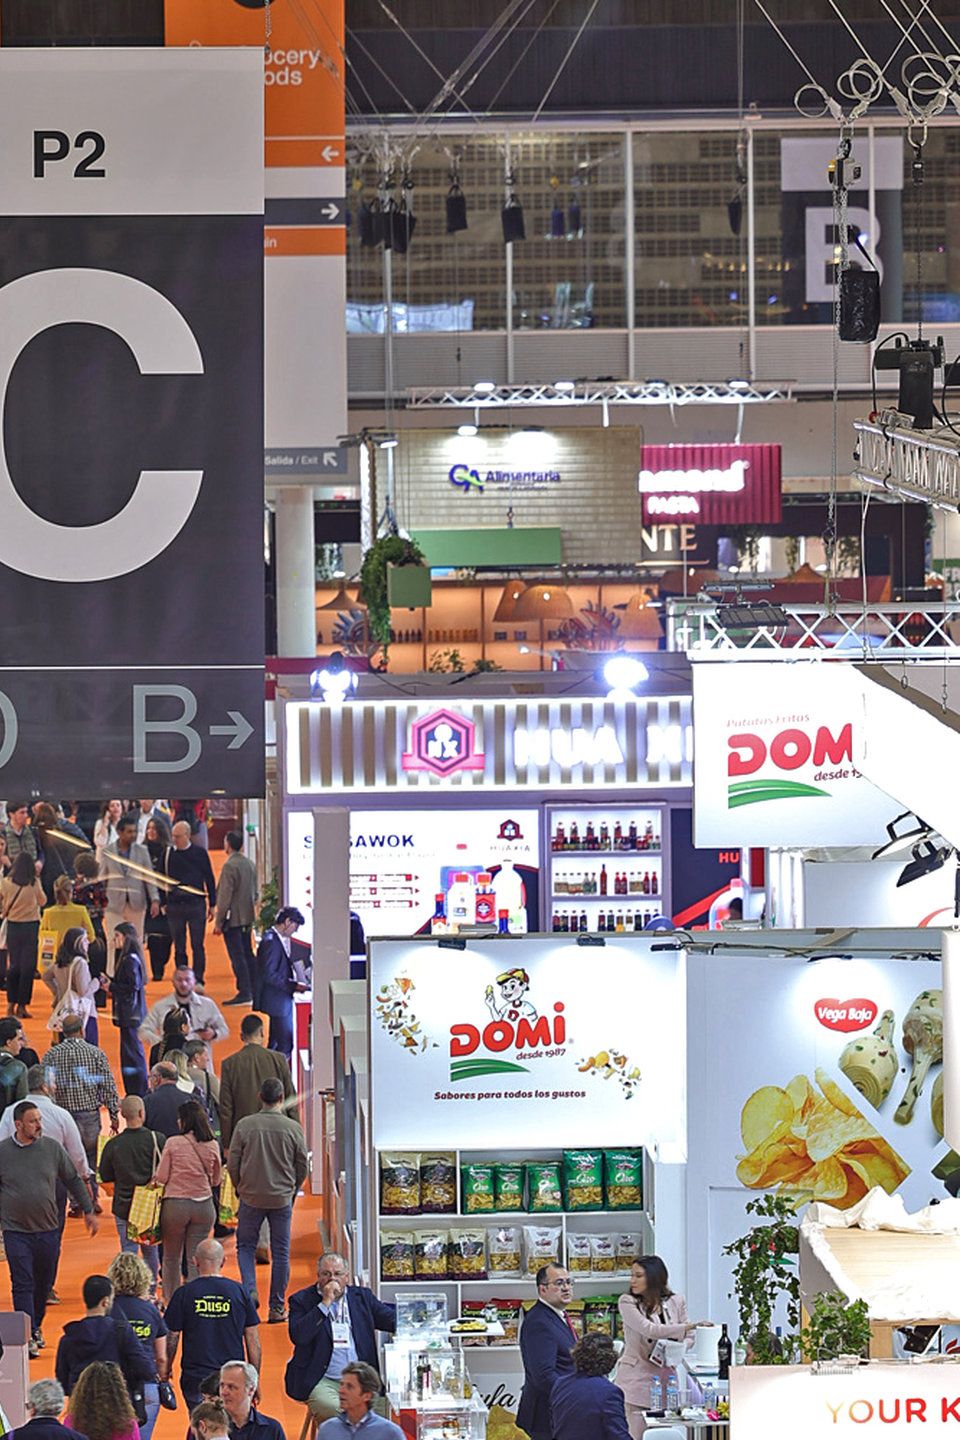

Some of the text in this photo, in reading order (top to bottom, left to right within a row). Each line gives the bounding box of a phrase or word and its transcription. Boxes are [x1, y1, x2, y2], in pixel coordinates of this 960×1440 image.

[265, 49, 320, 68] cery
[265, 68, 302, 85] ods
[33, 130, 106, 178] P2
[133, 685, 202, 773] B
[814, 768, 849, 781] desde
[817, 1006, 873, 1021] Vega Baja
[516, 1047, 566, 1061] desde 1987
[434, 1088, 587, 1101] Sabores para todos los gustos
[826, 1398, 927, 1424] YOUR
